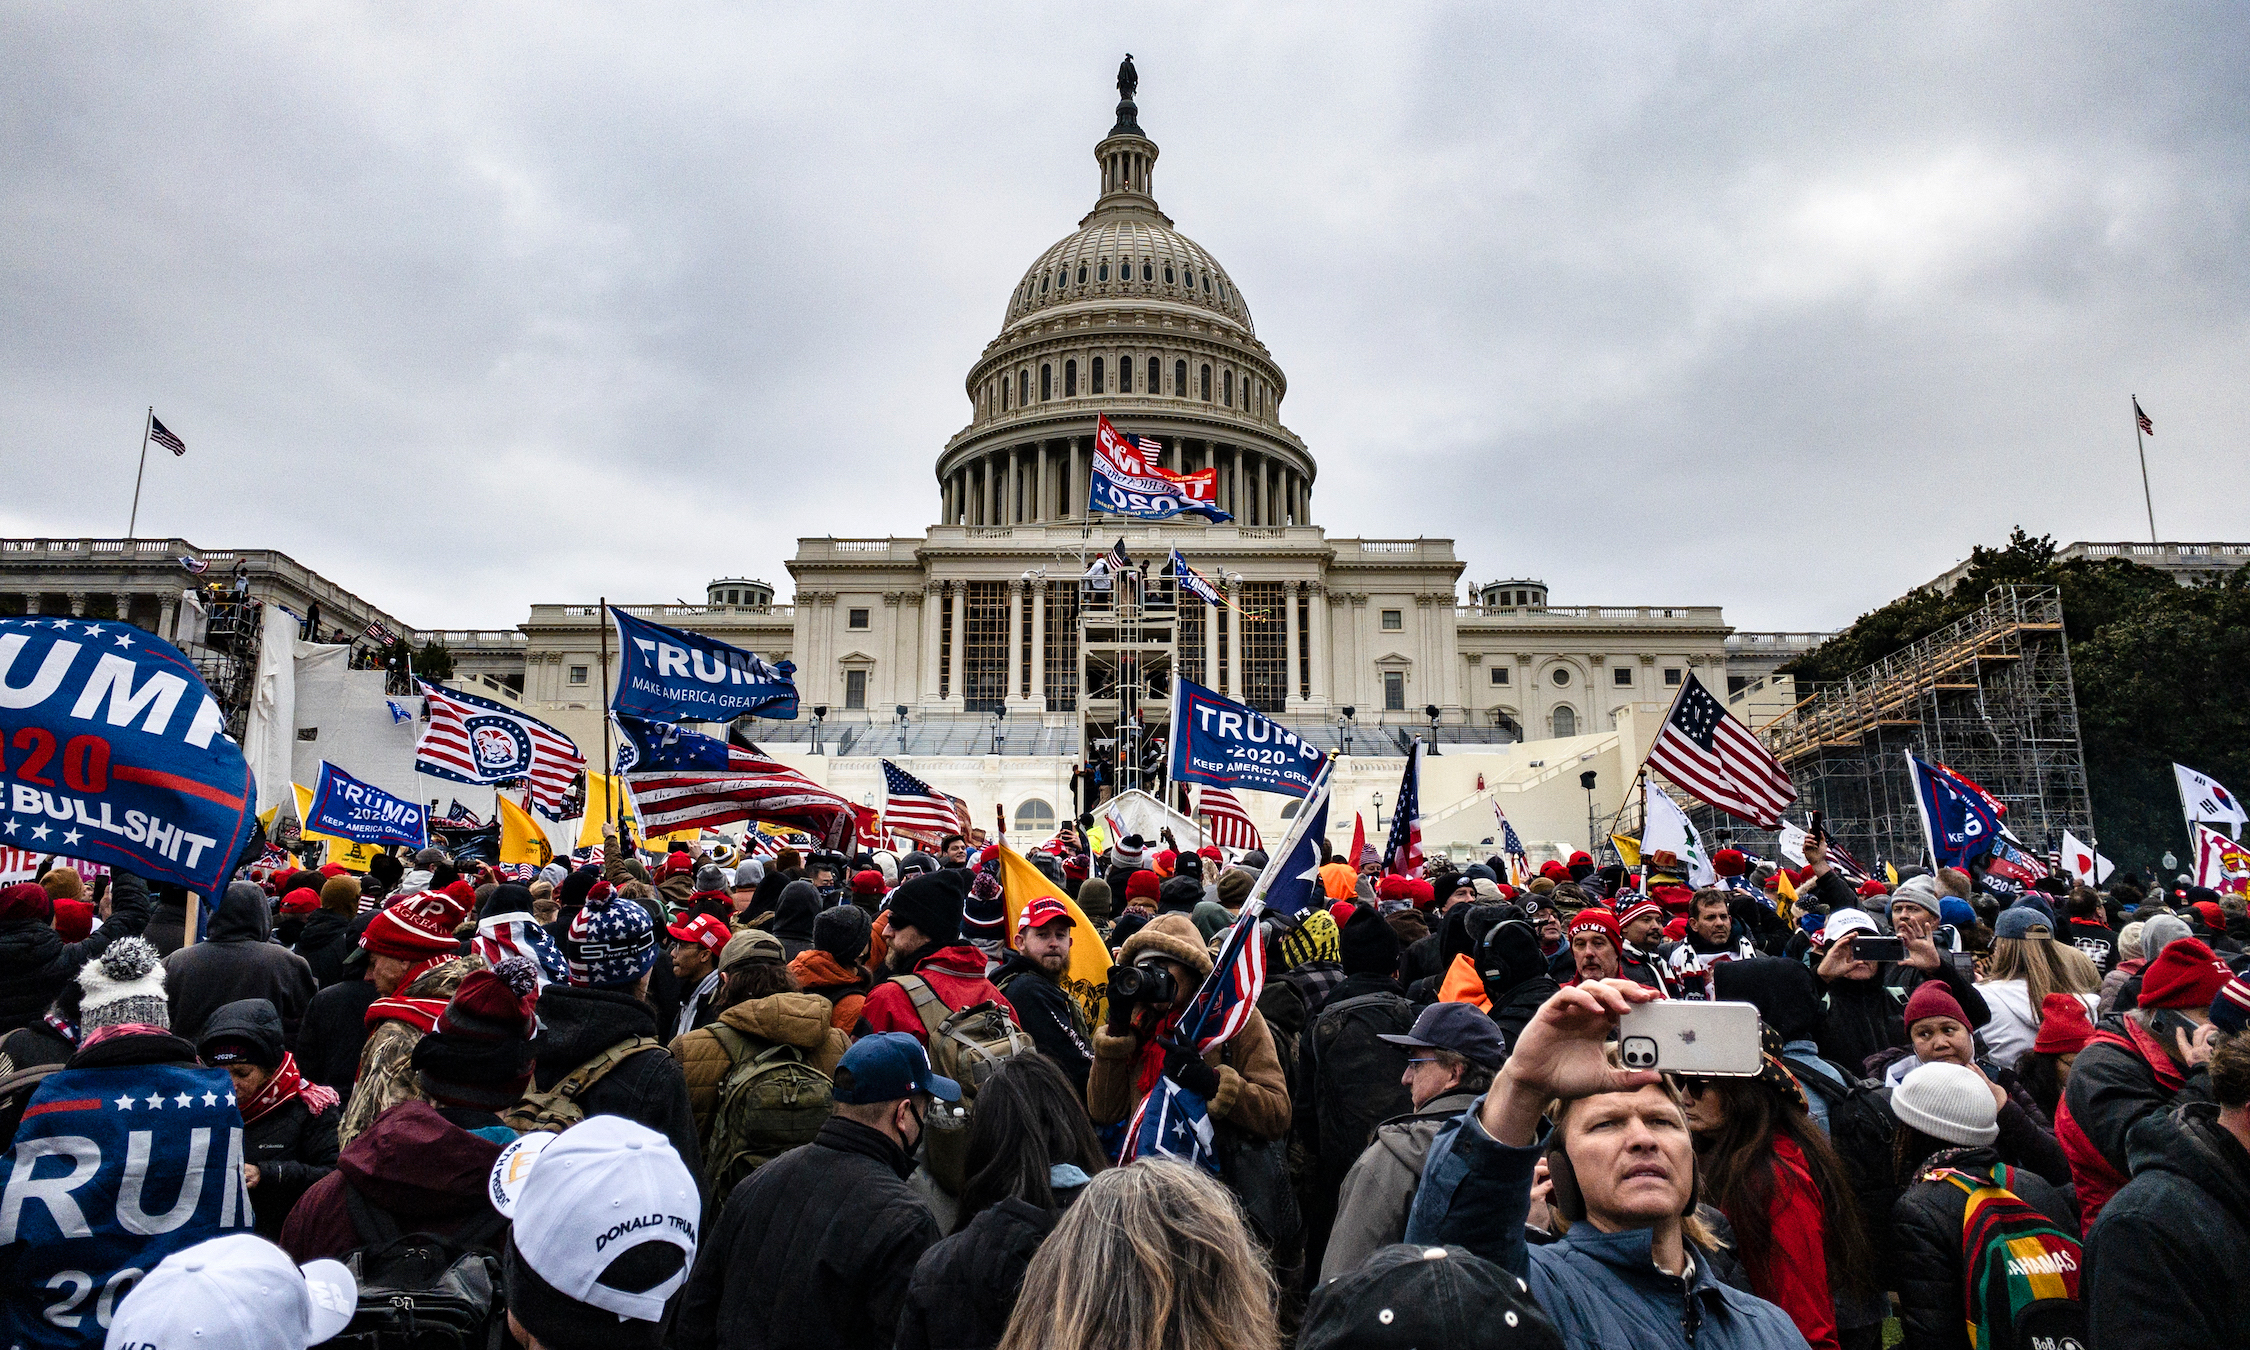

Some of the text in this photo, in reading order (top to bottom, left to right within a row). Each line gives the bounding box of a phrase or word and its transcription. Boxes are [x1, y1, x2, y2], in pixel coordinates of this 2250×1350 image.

[632, 676, 662, 697] MAKE
[662, 687, 716, 705] AMERICA
[719, 695, 757, 708] GREAT
[1195, 703, 1320, 762] TRUMP
[1226, 743, 1295, 765] -2020-
[1193, 757, 1316, 788] KEEP AMERICA GREA
[332, 776, 419, 827] TRUMP
[12, 783, 217, 869] BULLSHIT
[322, 814, 345, 827] KEEP
[346, 823, 383, 833] AMERICA
[1569, 922, 1607, 937] TRUMP
[492, 1142, 522, 1209] 45TH PRESIDENT
[596, 1213, 663, 1253] DONALD
[2007, 1249, 2078, 1276] AHAMAS
